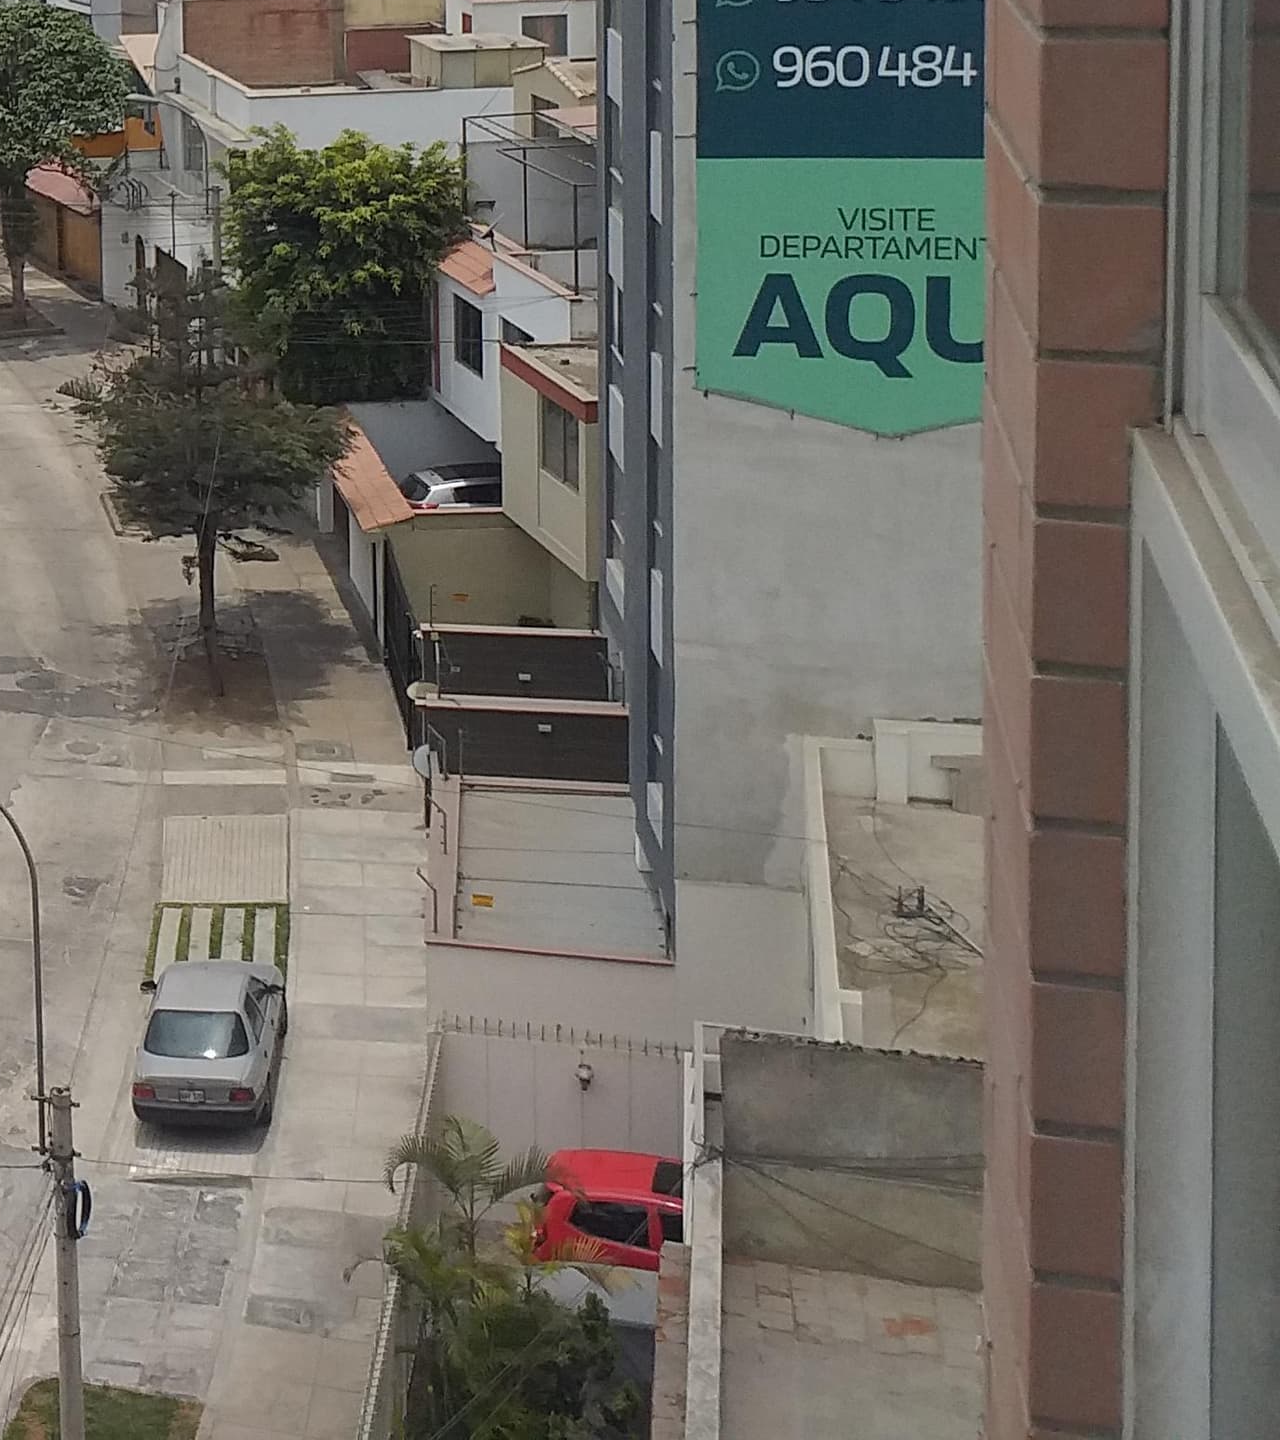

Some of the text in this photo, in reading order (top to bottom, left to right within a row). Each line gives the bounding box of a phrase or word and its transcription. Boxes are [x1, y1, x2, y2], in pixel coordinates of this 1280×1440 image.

[772, 45, 977, 88] 960 484
[837, 207, 936, 232] VISITE
[732, 273, 985, 379] AQU
